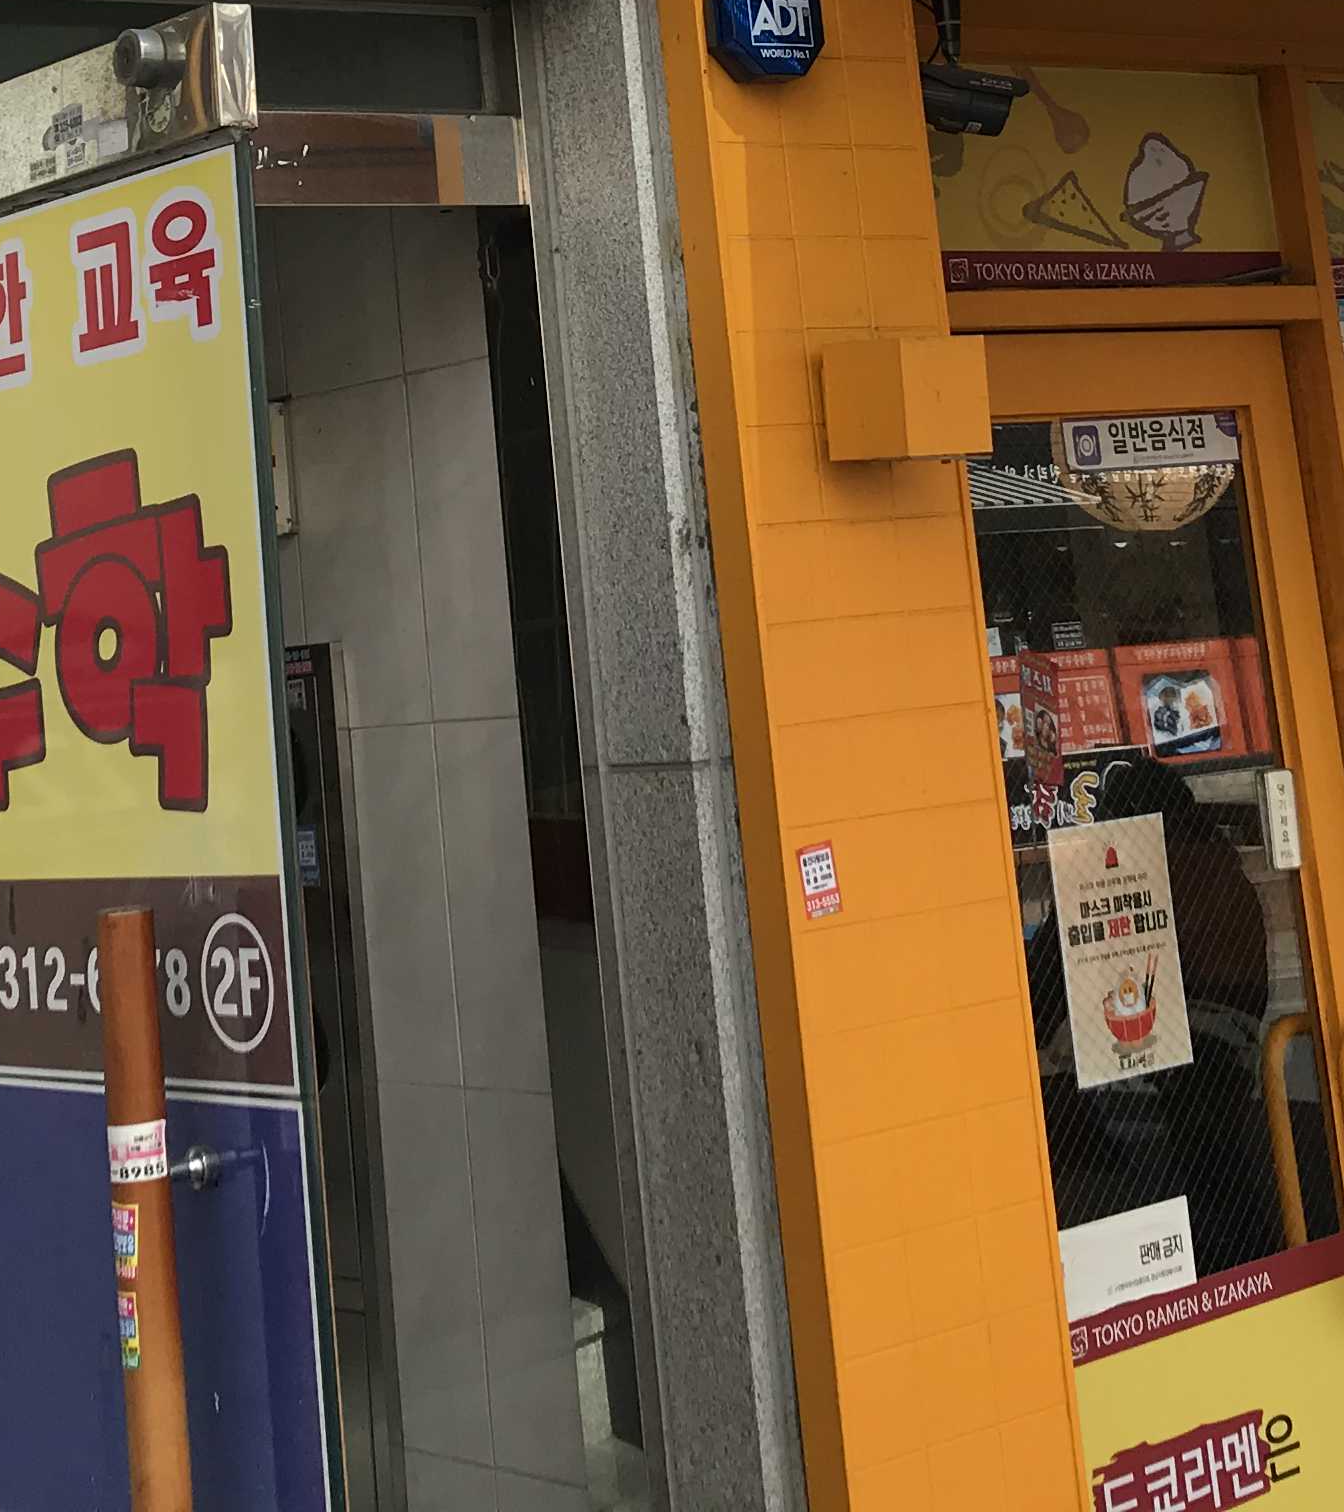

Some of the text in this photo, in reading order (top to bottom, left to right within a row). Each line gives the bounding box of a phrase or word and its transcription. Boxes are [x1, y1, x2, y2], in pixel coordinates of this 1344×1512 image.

[760, 48, 792, 58] WORLD
[76, 199, 216, 354] 교육
[973, 262, 1156, 281] TOKYO RAMEN & IZAKAYA
[1107, 417, 1206, 455] 일반음식점
[1079, 889, 1153, 920] 마스크 미착용시
[1067, 909, 1169, 947] 출입을 제한 합니다
[210, 945, 262, 1017] 2F
[1139, 1233, 1184, 1266] 판매 금지
[1092, 1315, 1144, 1349] TOKYO
[1146, 1294, 1200, 1332] RAMEN
[1201, 1292, 1213, 1311] &
[1213, 1271, 1274, 1307] IZAKAYA
